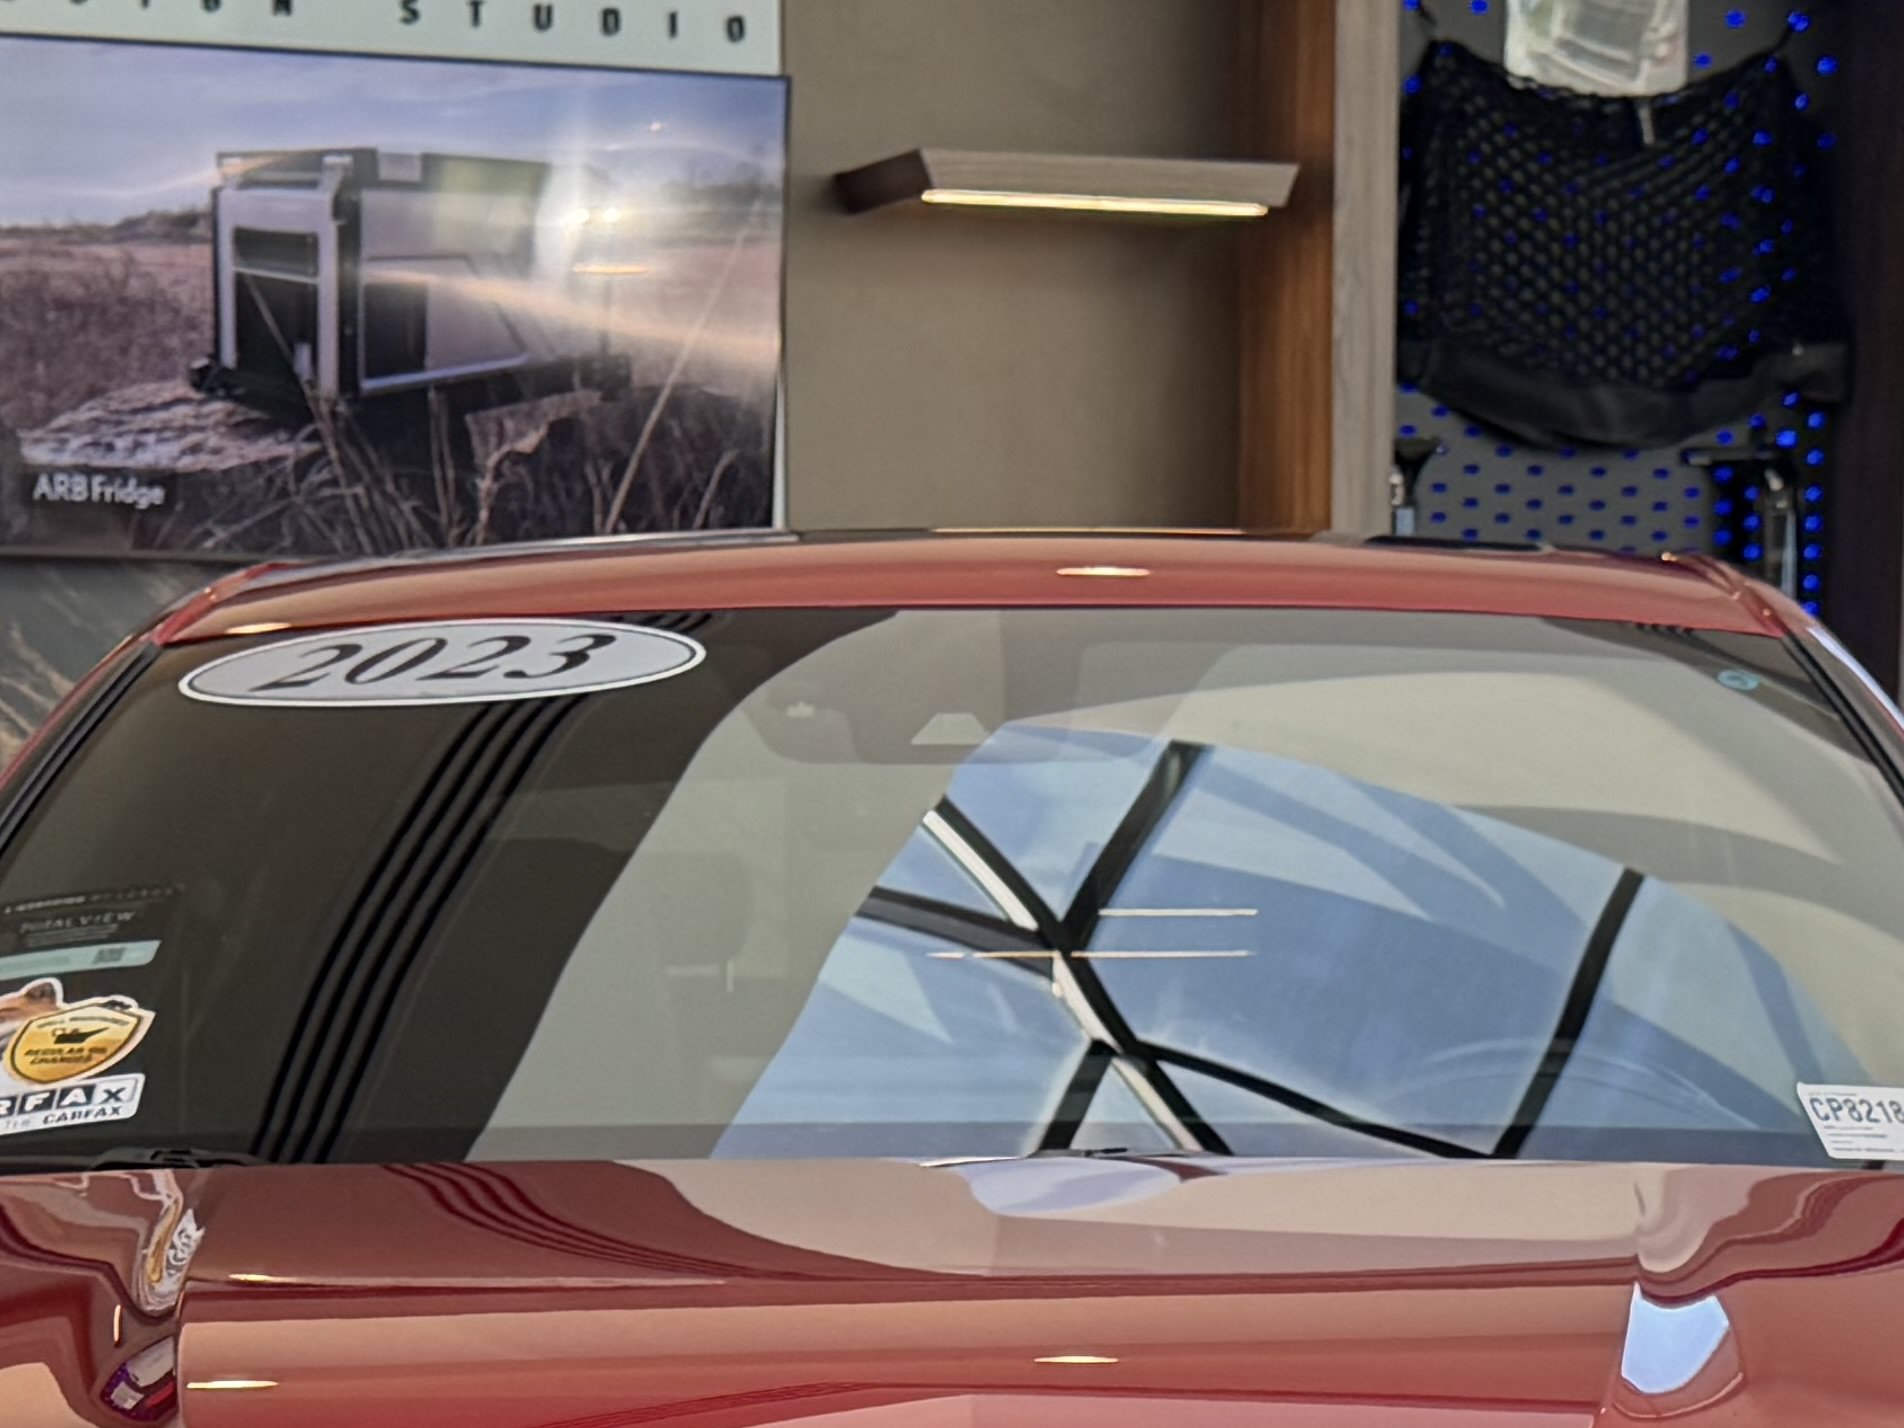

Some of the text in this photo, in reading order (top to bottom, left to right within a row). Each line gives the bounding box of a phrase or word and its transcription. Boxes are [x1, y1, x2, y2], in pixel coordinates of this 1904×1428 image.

[399, 0, 746, 43] STUDIO
[32, 472, 166, 509] ARB Fridge
[249, 633, 616, 692] 2023
[43, 1104, 122, 1125] CARFAX
